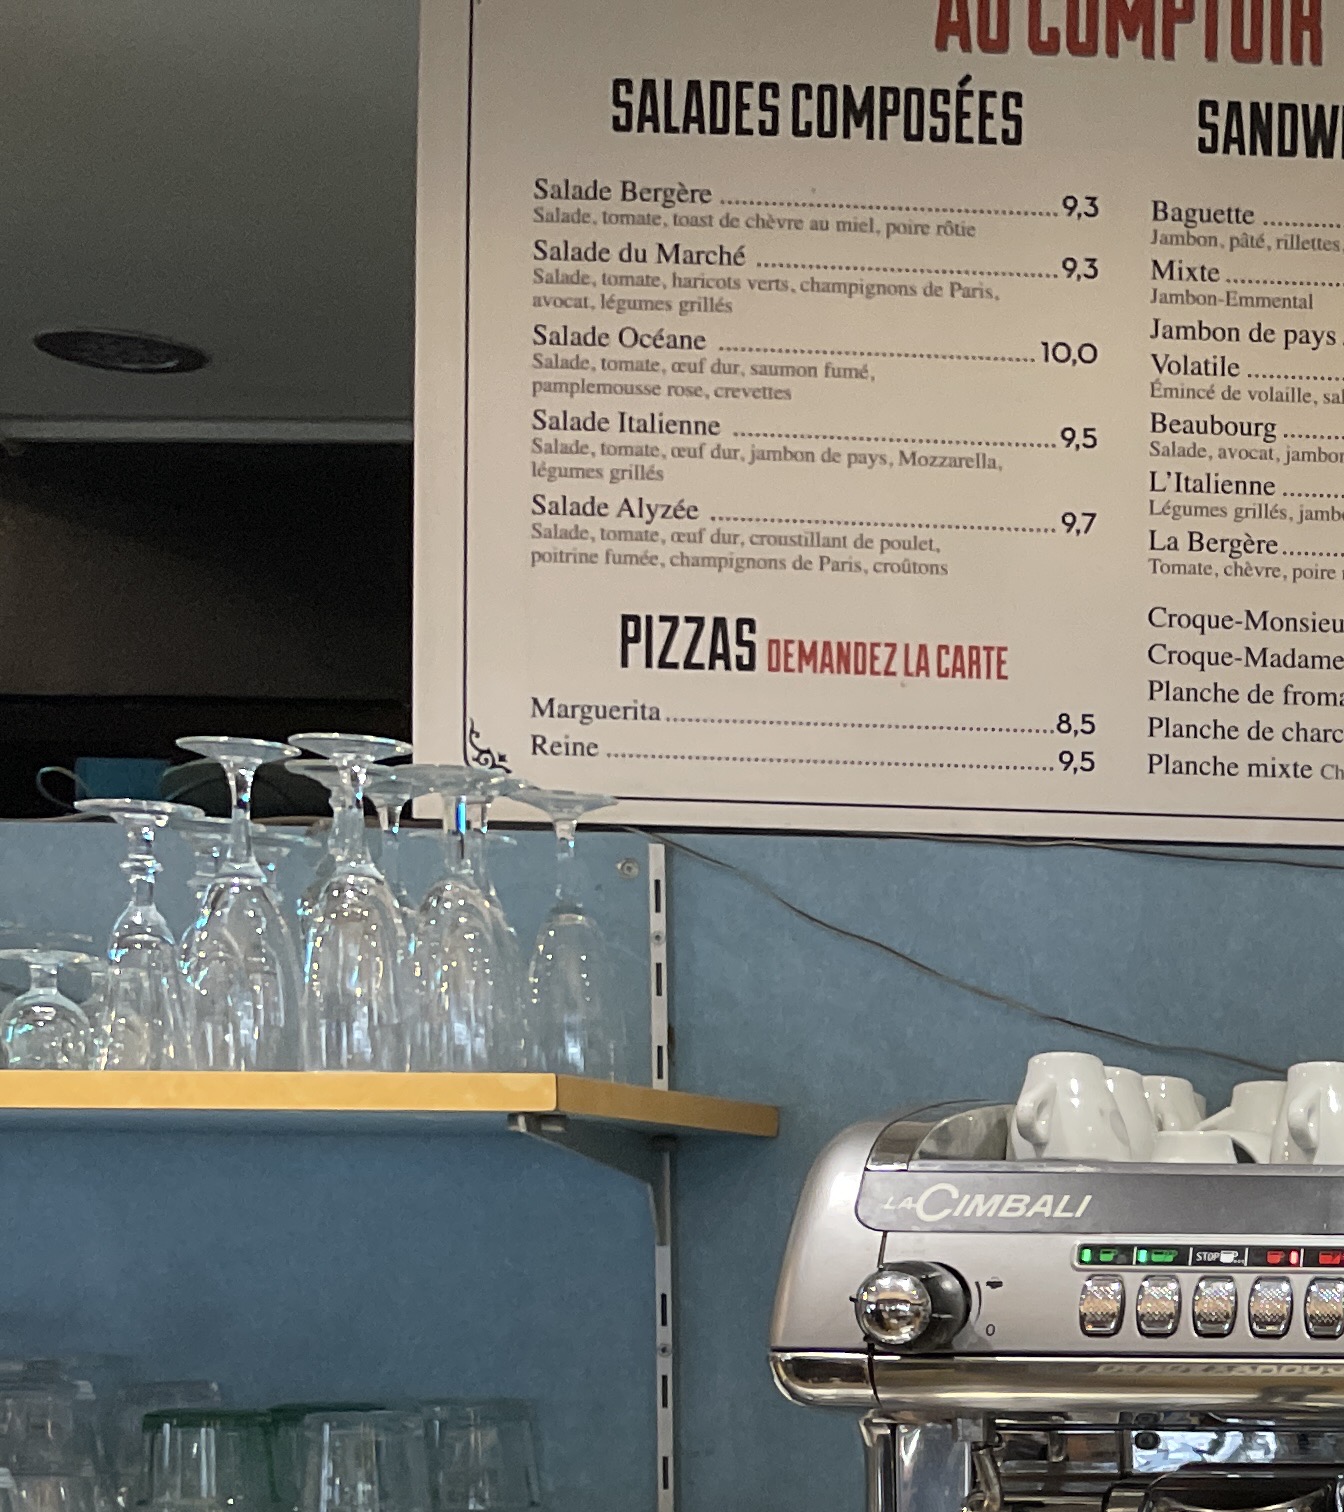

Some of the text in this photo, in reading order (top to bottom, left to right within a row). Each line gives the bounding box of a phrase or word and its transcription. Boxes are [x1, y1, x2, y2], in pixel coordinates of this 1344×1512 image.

[611, 73, 1024, 146] SALADES COMPOSÉES
[533, 177, 1099, 221] Salade Bergère 9,3
[672, 212, 714, 228] toast
[744, 212, 805, 232] chèvre
[885, 218, 931, 241] poire
[935, 218, 977, 238] rôtie
[1152, 200, 1255, 231] Baguette
[533, 239, 1098, 283] Salade du Marché 9,3
[1151, 259, 1220, 283] Mixte
[671, 271, 742, 290] haricots
[799, 275, 918, 302] champignons
[600, 292, 674, 317] légumes
[678, 294, 733, 319] grillés
[532, 324, 1098, 367] Salade Océane 10,0
[1149, 318, 1241, 342] Jambon
[1248, 322, 1276, 343] de
[1283, 329, 1337, 351] pays
[749, 363, 818, 378] saumon
[1151, 354, 1241, 378] Volatile
[531, 375, 792, 402] pamplemousse crevettes
[1149, 378, 1219, 400] Émincé
[532, 409, 1097, 452] Salade Italienne 9,5
[1151, 412, 1277, 443] Beaubourg
[747, 444, 816, 469] jambon
[531, 459, 665, 487] légumes grillés
[531, 494, 1097, 537] Salade Alyzée 9,7
[1149, 498, 1230, 524] Légumes
[748, 529, 848, 549] croustillant
[1149, 530, 1179, 552] La
[1188, 531, 1278, 561] Bergère
[530, 546, 599, 569] poitrine
[669, 549, 787, 575] champignons
[872, 555, 949, 575] croûtons
[1292, 562, 1337, 585] poire
[620, 613, 1009, 681] PIZZAS DEMANDEZ LA CARTE
[1147, 643, 1344, 676] Croque-Madame
[1148, 680, 1240, 704] Planche
[1246, 683, 1275, 705] de
[531, 696, 1096, 738] Marguerita 8,5
[1148, 717, 1240, 741] Planche
[1246, 720, 1275, 742] de
[531, 734, 1095, 776] Reine 9,5
[1148, 753, 1240, 777] Planche
[1247, 757, 1313, 779] mixte
[882, 1182, 1093, 1222] LA CIMBALI
[1195, 1251, 1221, 1262] STOP
